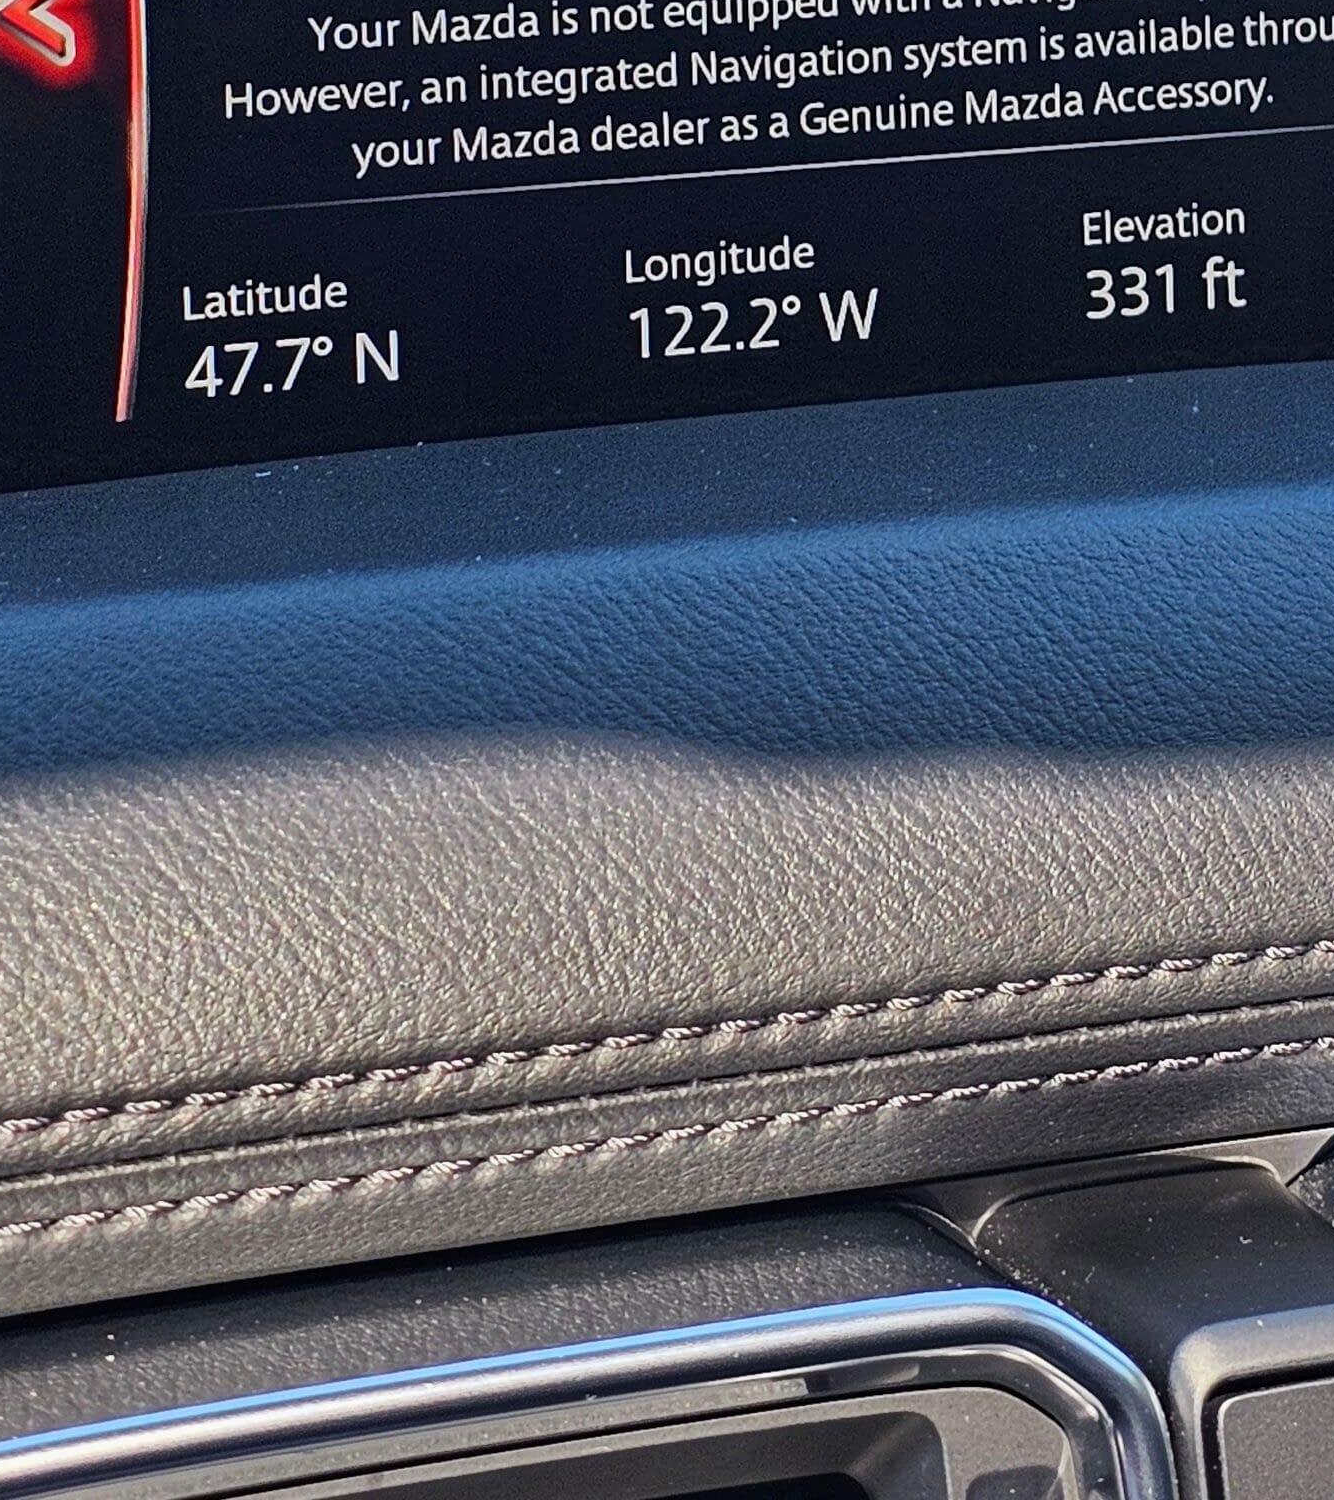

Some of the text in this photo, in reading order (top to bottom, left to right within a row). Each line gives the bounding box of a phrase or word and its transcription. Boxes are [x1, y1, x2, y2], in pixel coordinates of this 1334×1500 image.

[307, 16, 402, 52] Your
[412, 2, 542, 46] Mazda
[224, 80, 411, 120] However,
[420, 75, 468, 106] an
[480, 50, 679, 105] integrated
[690, 37, 893, 89] Navigation
[903, 35, 1028, 79] system
[1039, 25, 1065, 62] is
[1074, 13, 1236, 60] available
[350, 76, 1275, 180] your Mazda dealer as a Genuine Mazda Accessory.
[1082, 200, 1246, 246] Elevation
[624, 234, 816, 287] Longitude
[1085, 255, 1249, 320] 331 ft
[181, 272, 349, 321] Latitude
[628, 287, 880, 359] 122.2° W
[183, 329, 401, 398] 47.7° N
